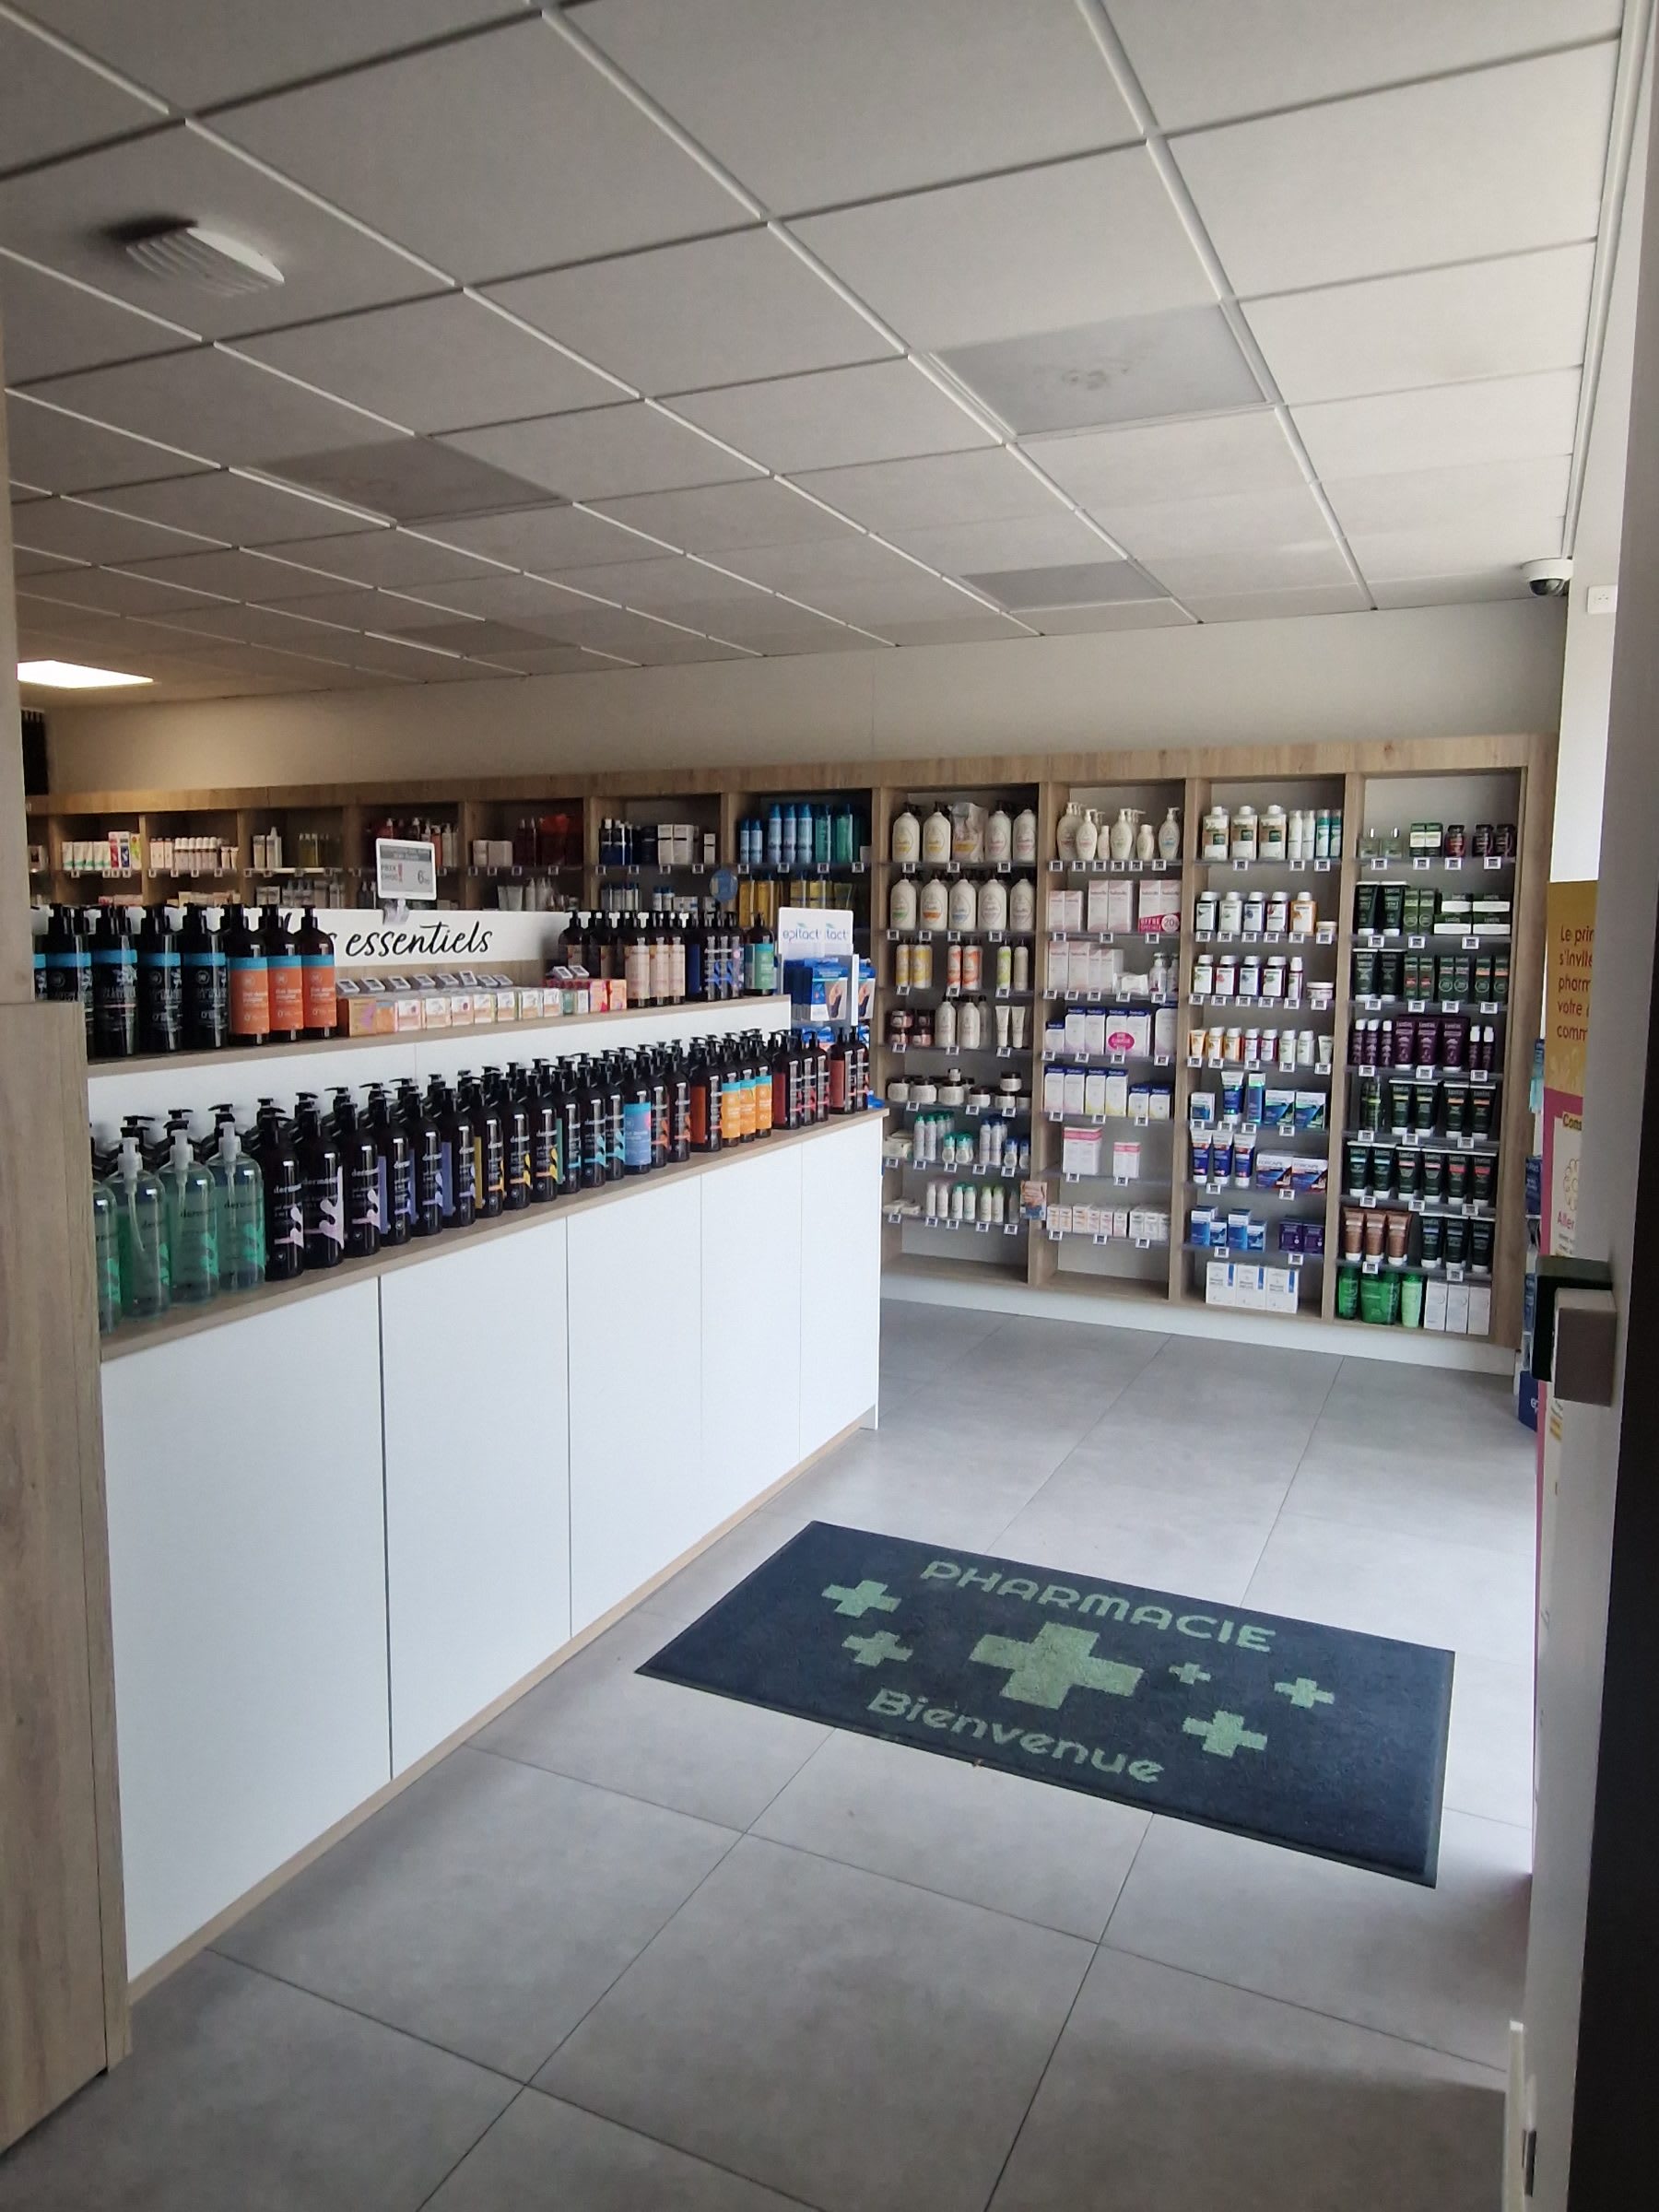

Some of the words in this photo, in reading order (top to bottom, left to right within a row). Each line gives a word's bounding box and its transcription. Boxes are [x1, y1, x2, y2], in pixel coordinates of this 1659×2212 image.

[346, 921, 492, 958] essentiels
[1560, 924, 1571, 942] Le
[1558, 998, 1583, 1018] votre
[922, 1559, 1277, 1653] PHARMACIE
[865, 1688, 1165, 1783] Bienvenue
